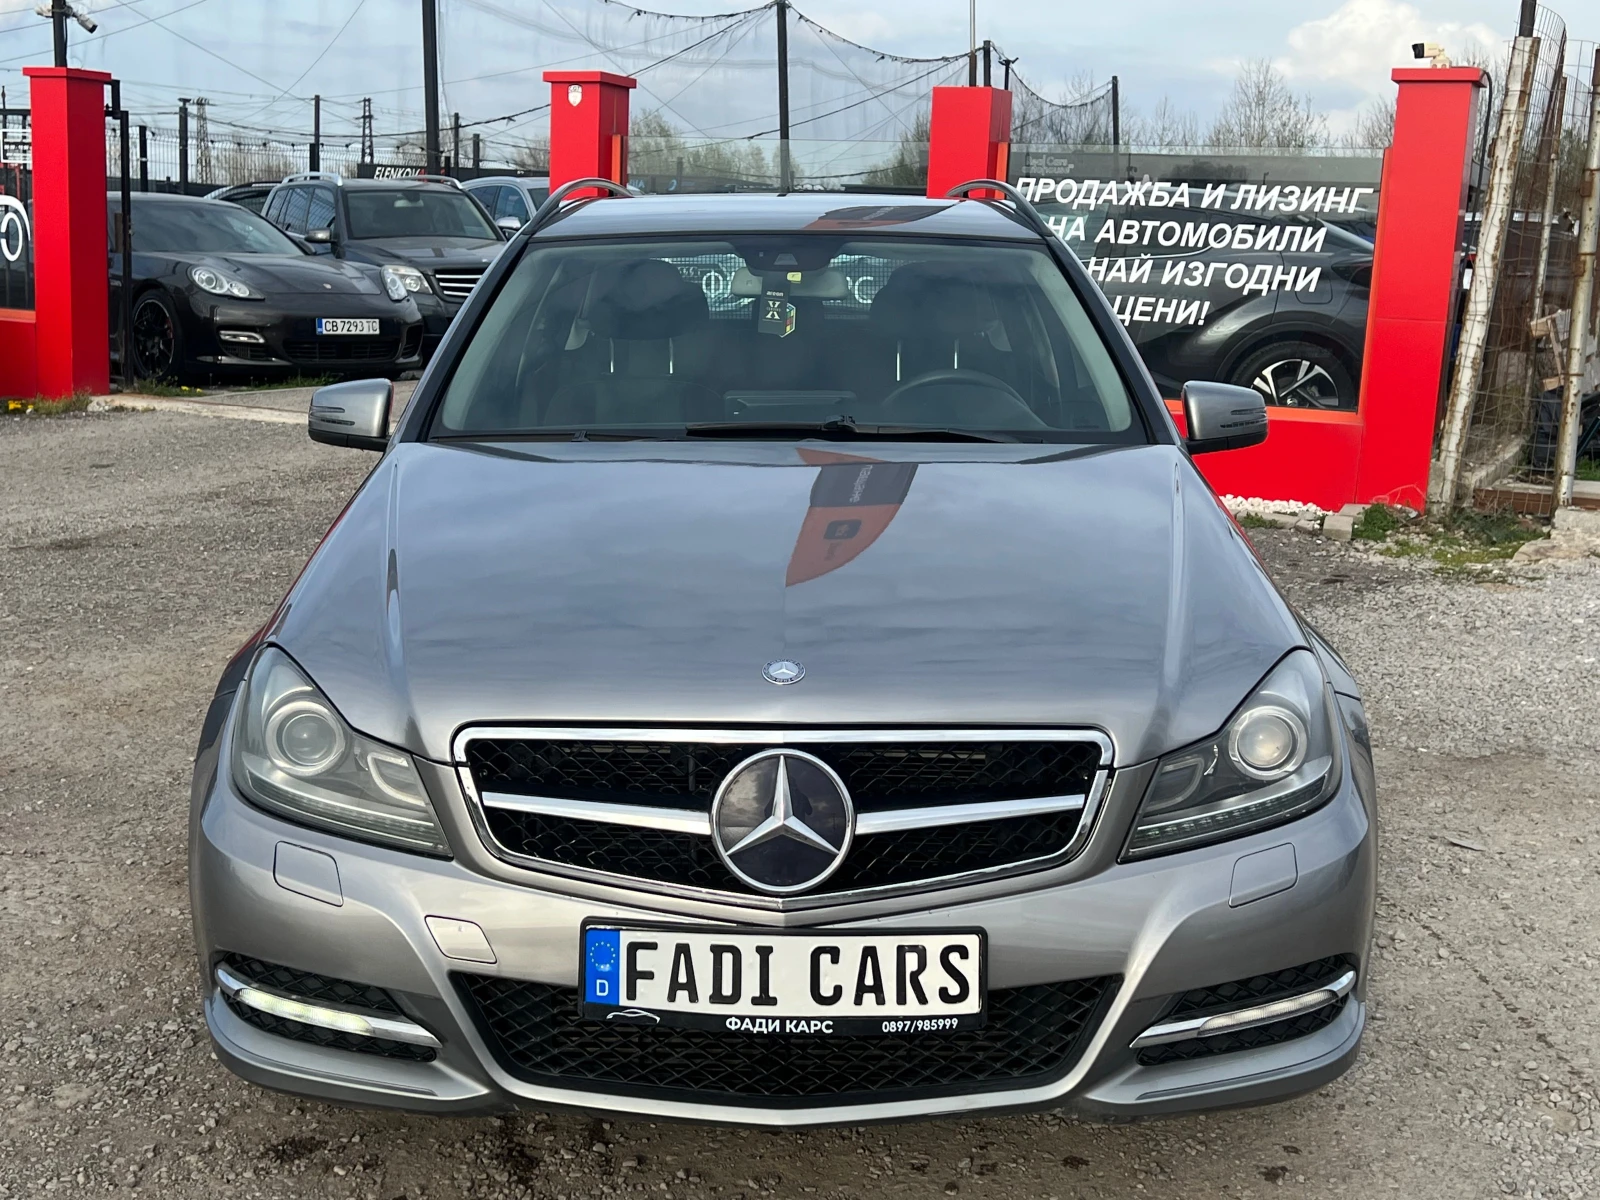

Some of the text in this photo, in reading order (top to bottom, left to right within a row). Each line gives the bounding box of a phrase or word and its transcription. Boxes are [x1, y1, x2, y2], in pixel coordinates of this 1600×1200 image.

[1016, 177, 1374, 213] ПРОДАЖБА И ЛИЗИНГ
[1047, 216, 1328, 253] НА АВТОМОБИЛИ
[1088, 253, 1322, 297] НАЙ ИЗГОДНИ
[1113, 295, 1211, 327] ЦЕНИ!
[596, 979, 609, 997] D
[626, 941, 970, 1006] FADI CARS
[725, 1016, 959, 1034] ФАДИ КАРС 0897/985999
